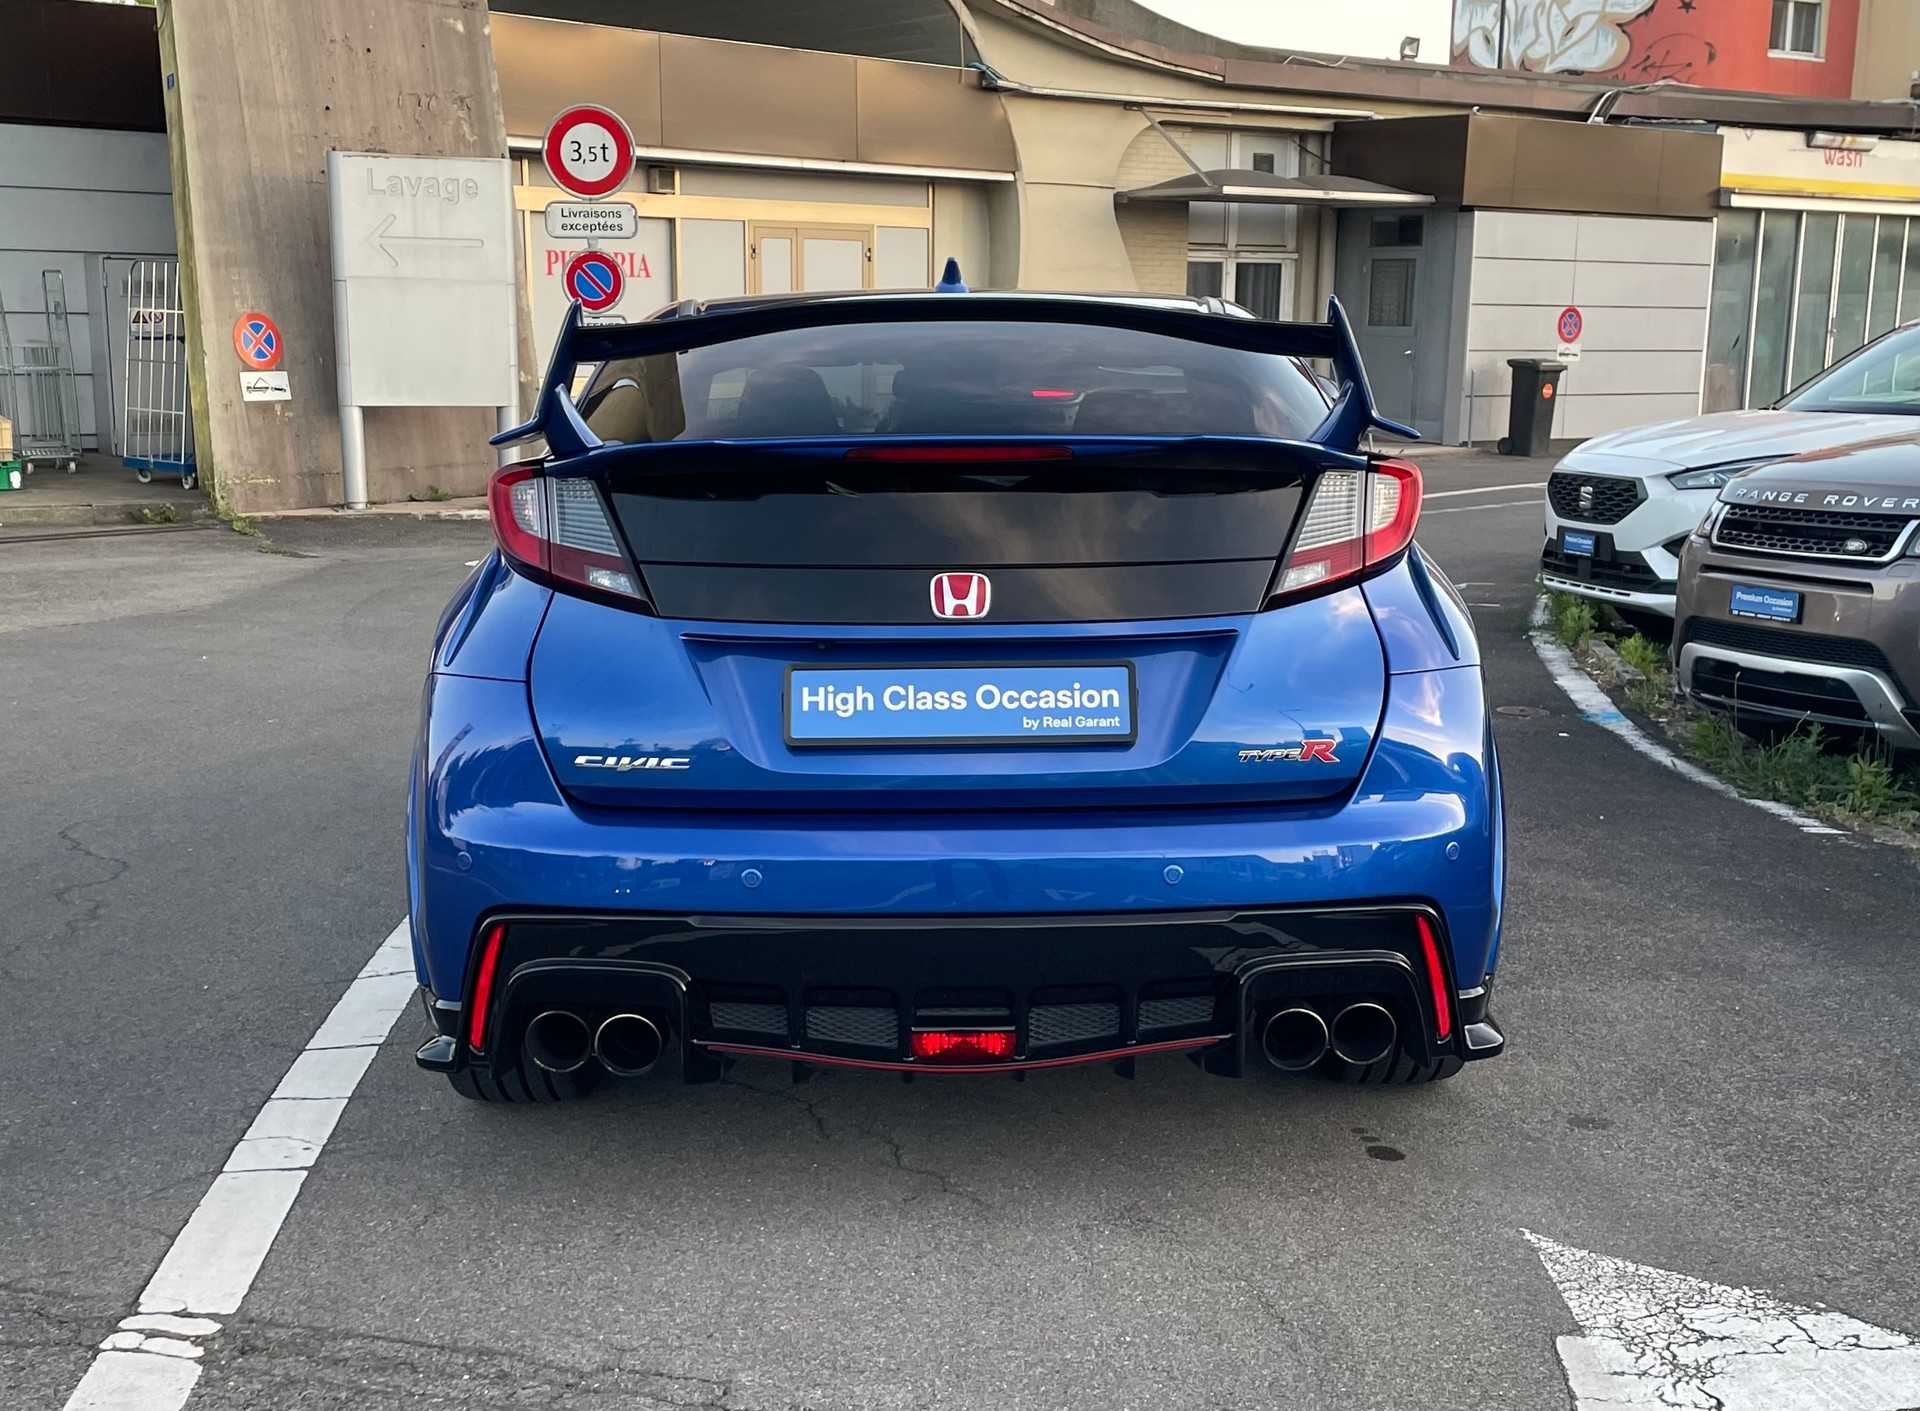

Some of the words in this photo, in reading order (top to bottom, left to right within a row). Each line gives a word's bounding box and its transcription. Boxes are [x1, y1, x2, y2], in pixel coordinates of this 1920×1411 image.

[366, 167, 479, 205] Lavage
[560, 207, 622, 219] Livraisons
[561, 220, 623, 235] exceptées
[545, 249, 652, 278] PIRIA
[1735, 488, 1809, 503] RANGE
[1823, 494, 1920, 509] ROVER
[802, 685, 874, 718] High
[883, 685, 968, 711] Class
[975, 683, 1120, 710] Occasion
[1022, 716, 1040, 731] by
[1042, 716, 1073, 729] Real
[1074, 715, 1121, 728] Garant
[574, 755, 691, 771] CIVIC
